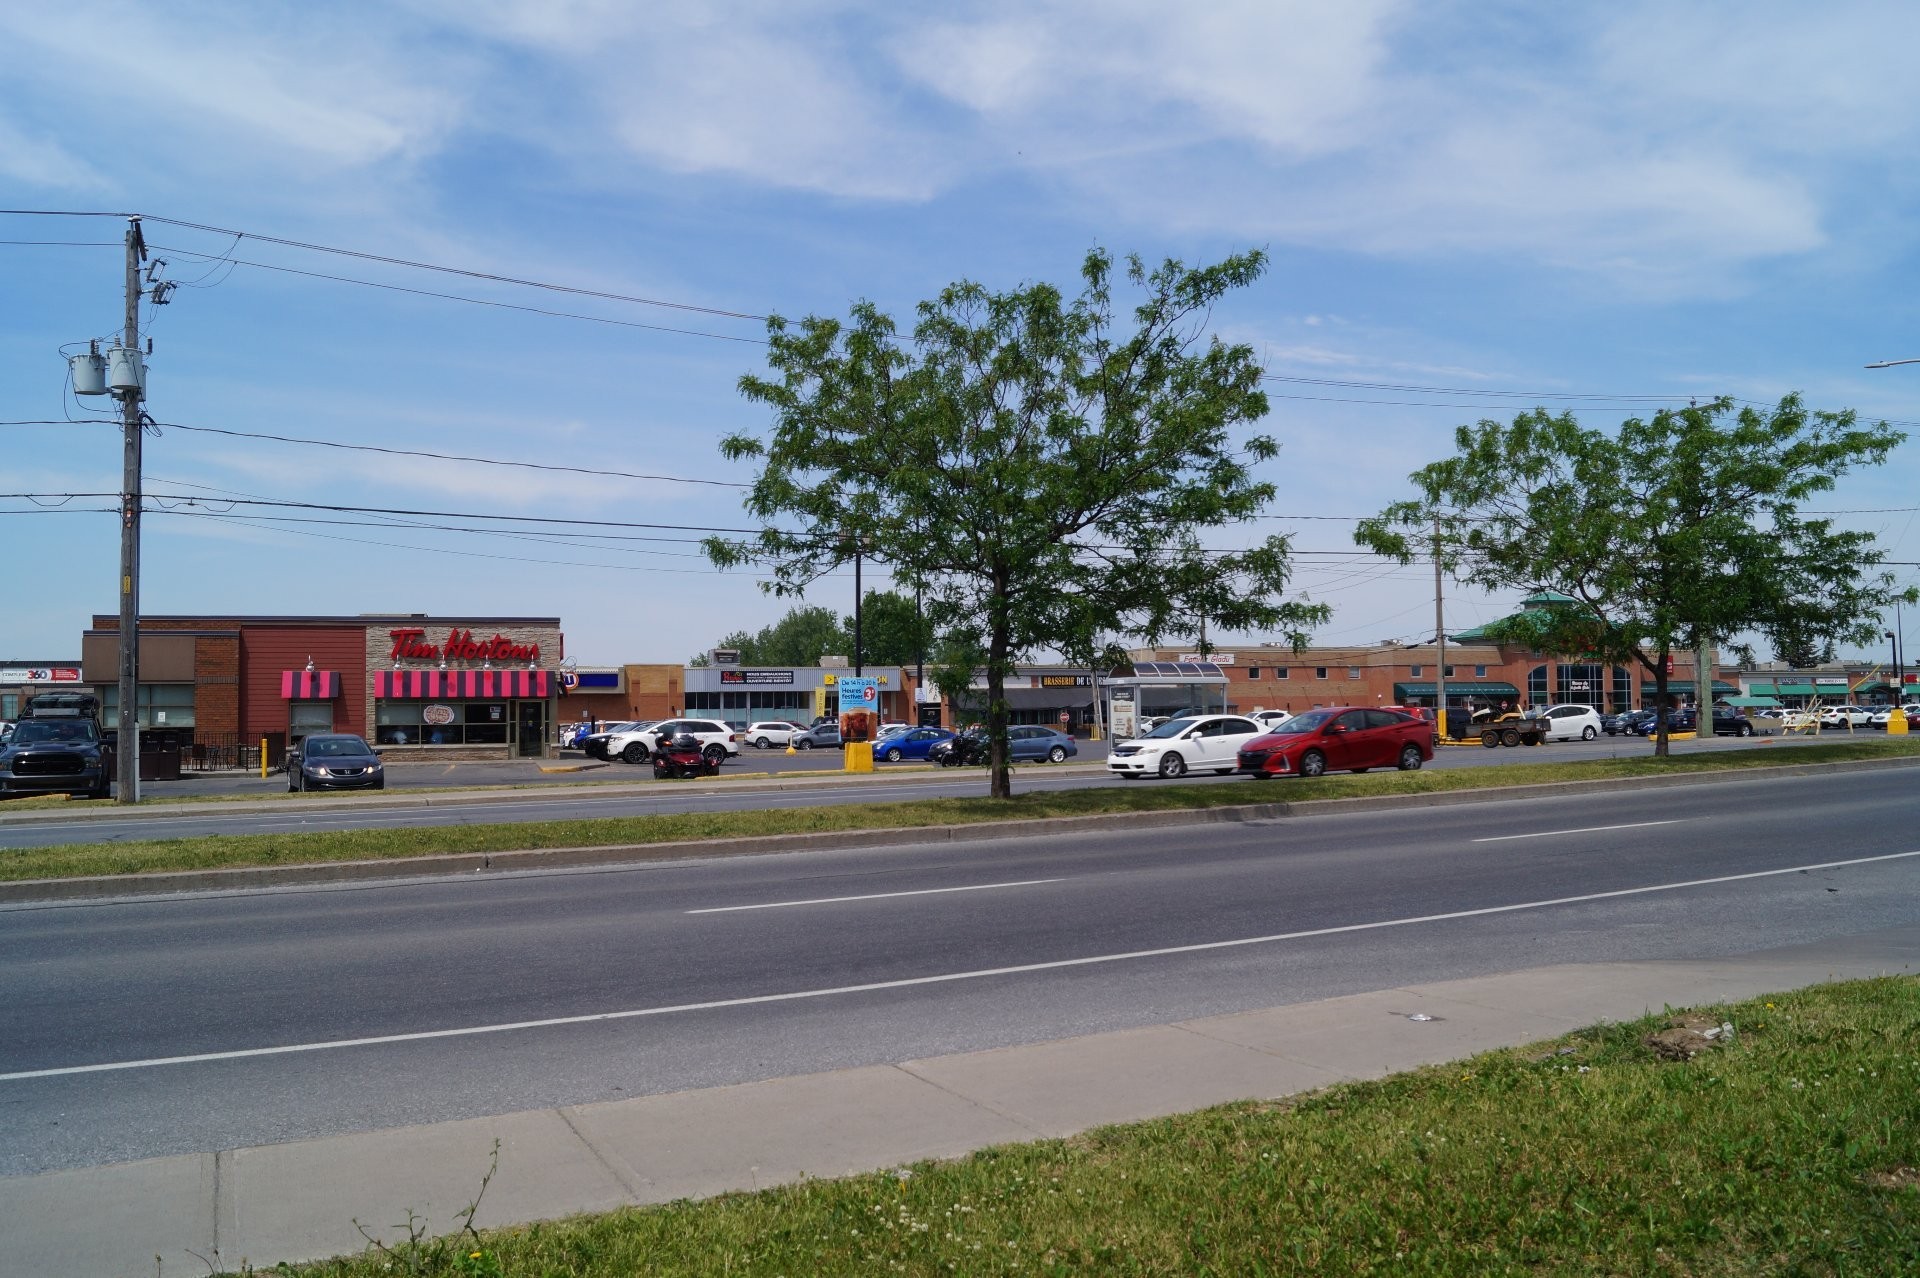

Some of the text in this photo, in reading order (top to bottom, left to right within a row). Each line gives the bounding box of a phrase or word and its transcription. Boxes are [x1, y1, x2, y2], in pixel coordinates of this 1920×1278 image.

[389, 627, 539, 660] Tim Hortons
[28, 670, 48, 679] 360
[1043, 676, 1075, 686] BRASSERIE
[1076, 676, 1085, 686] DE
